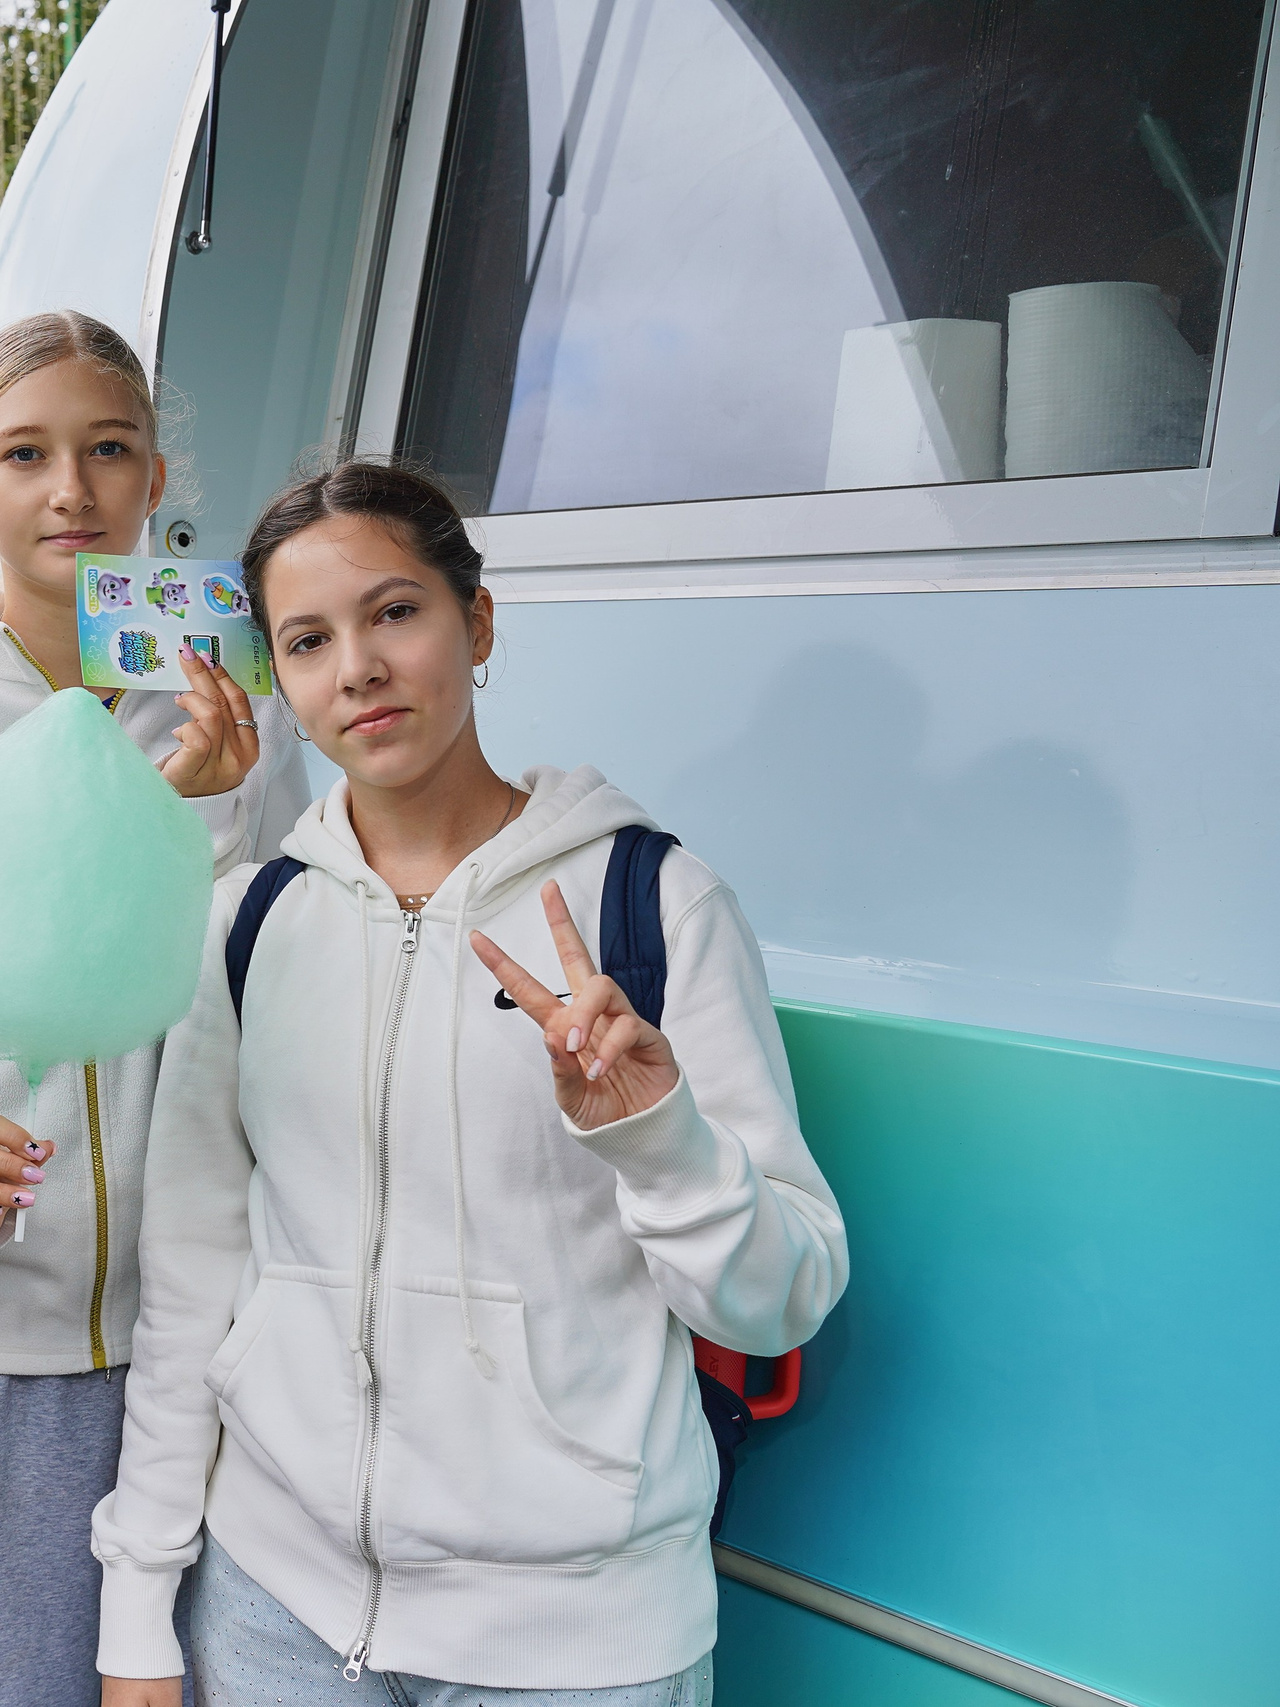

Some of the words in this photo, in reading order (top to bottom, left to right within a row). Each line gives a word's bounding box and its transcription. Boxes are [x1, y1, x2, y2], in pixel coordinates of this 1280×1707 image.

[89, 570, 98, 612] КОТОСТЬ
[160, 568, 179, 582] 6
[167, 607, 186, 620] 7
[119, 631, 137, 674] ДЕЙСТВУЙ
[131, 633, 148, 671] МЕЧТАЙ
[142, 636, 158, 672] УЧИСЬ
